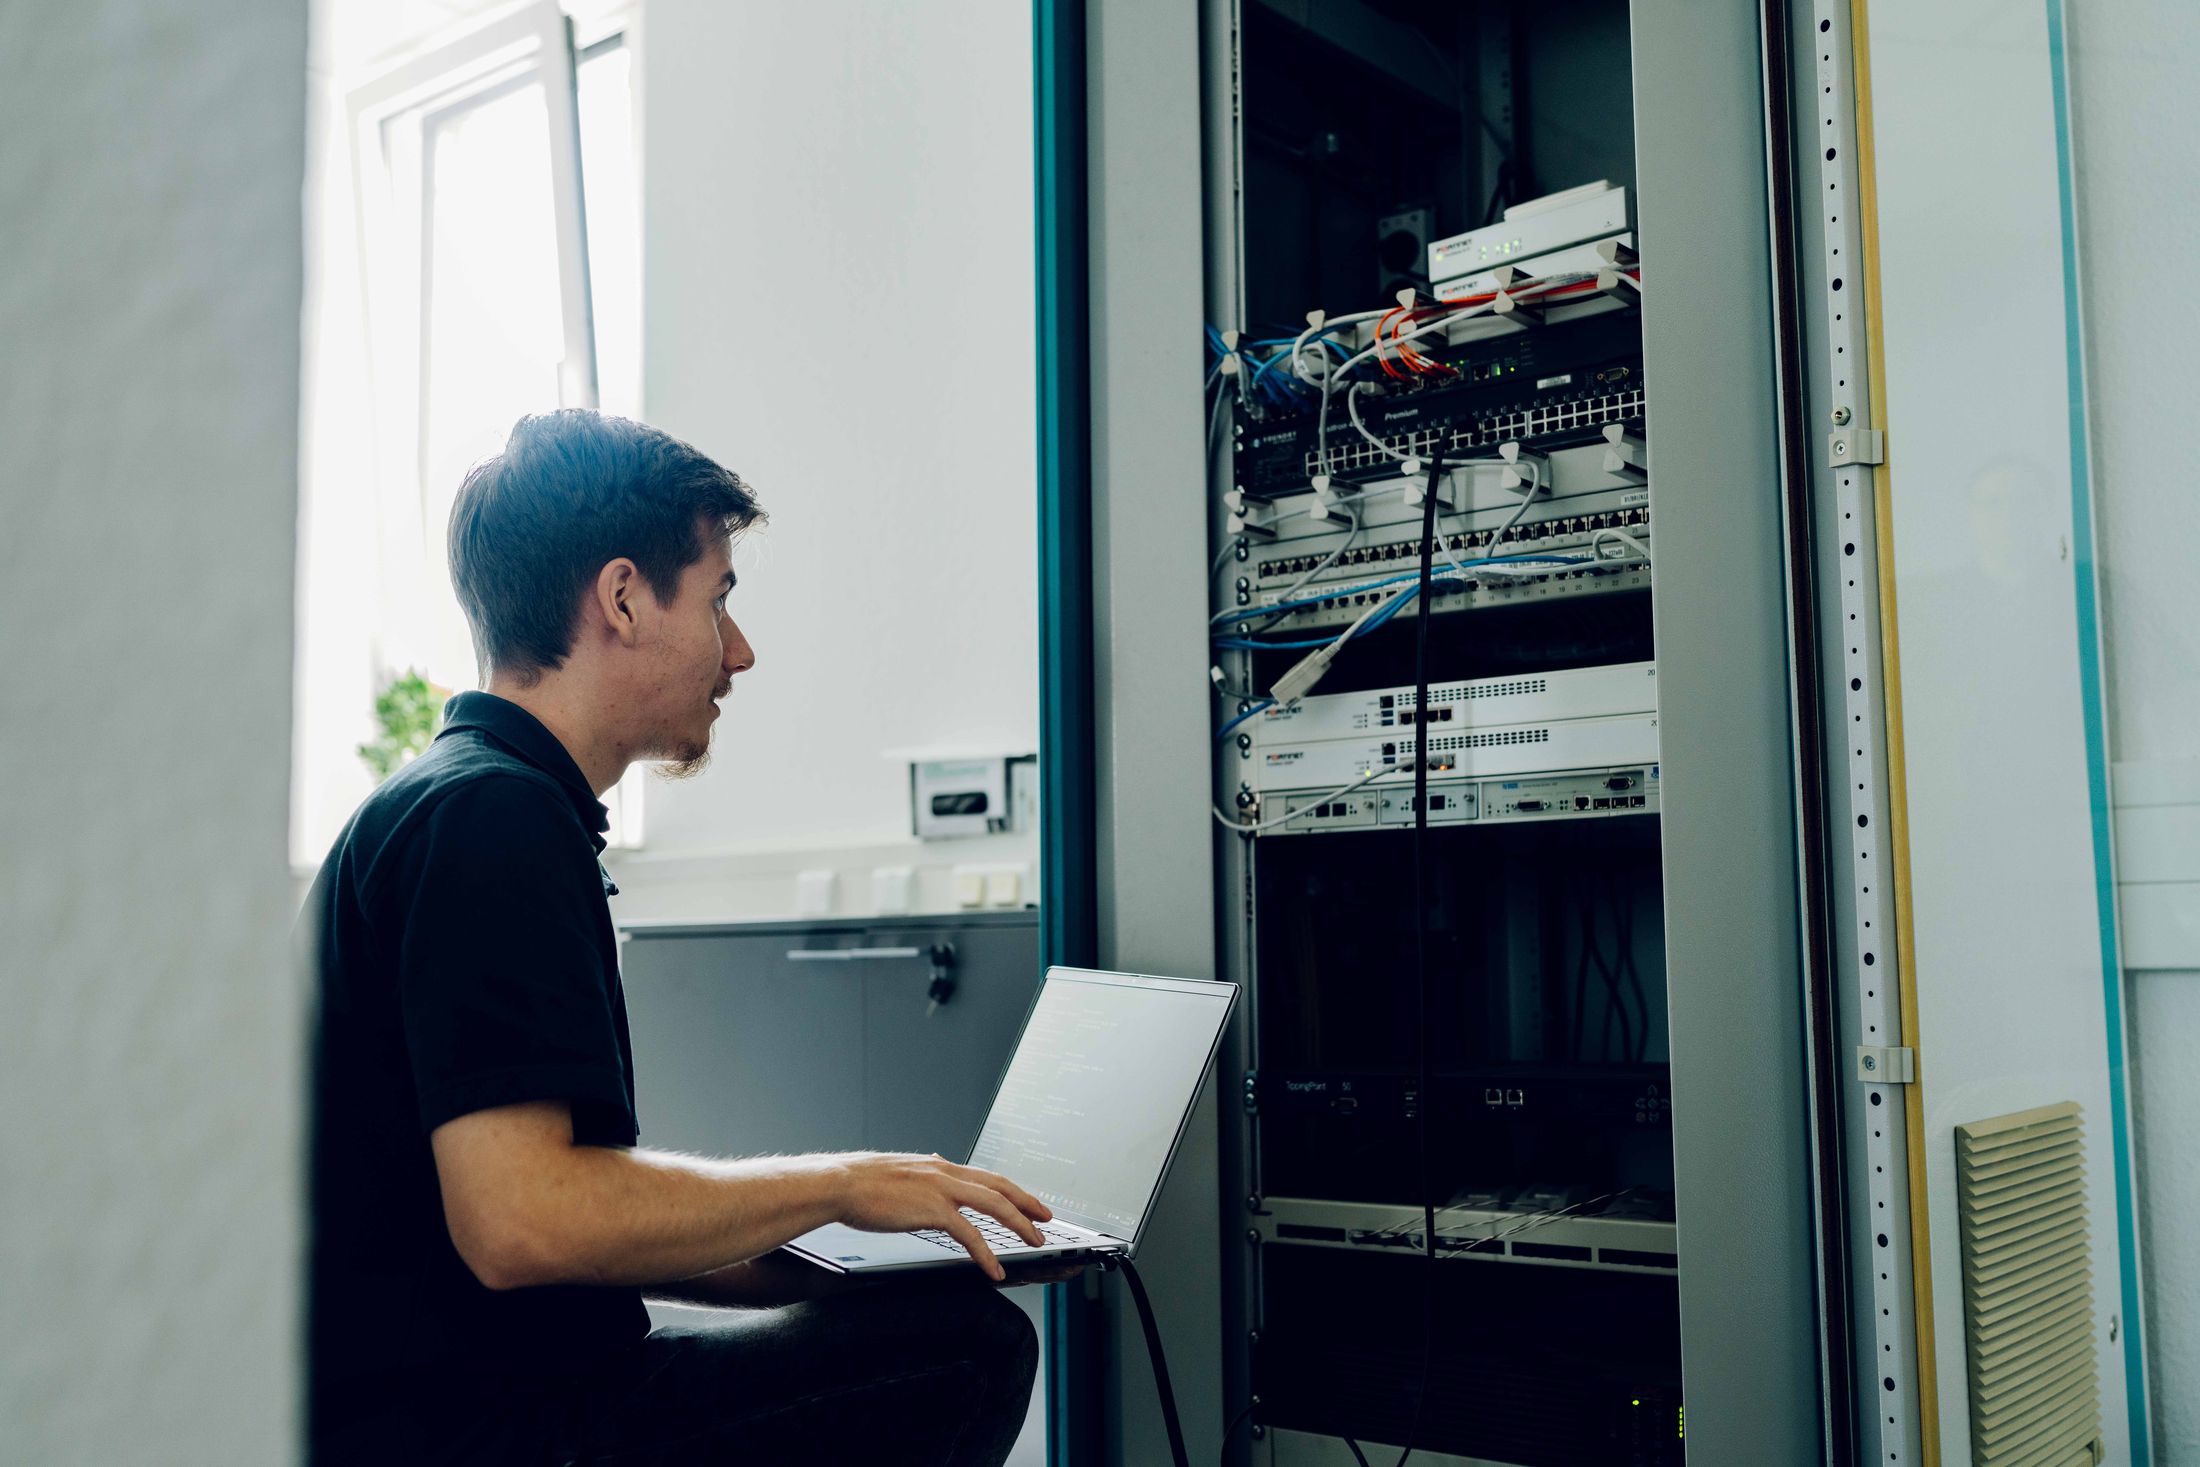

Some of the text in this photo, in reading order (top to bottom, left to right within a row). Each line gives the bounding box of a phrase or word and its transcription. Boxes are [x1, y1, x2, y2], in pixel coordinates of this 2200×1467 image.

[1436, 239, 1472, 253] FORTINET
[1441, 281, 1478, 295] FORTINET
[1385, 408, 1419, 421] Premium
[1631, 576, 1640, 584] 23
[1264, 706, 1303, 716] FORTINET
[1266, 752, 1305, 762] FORTINET
